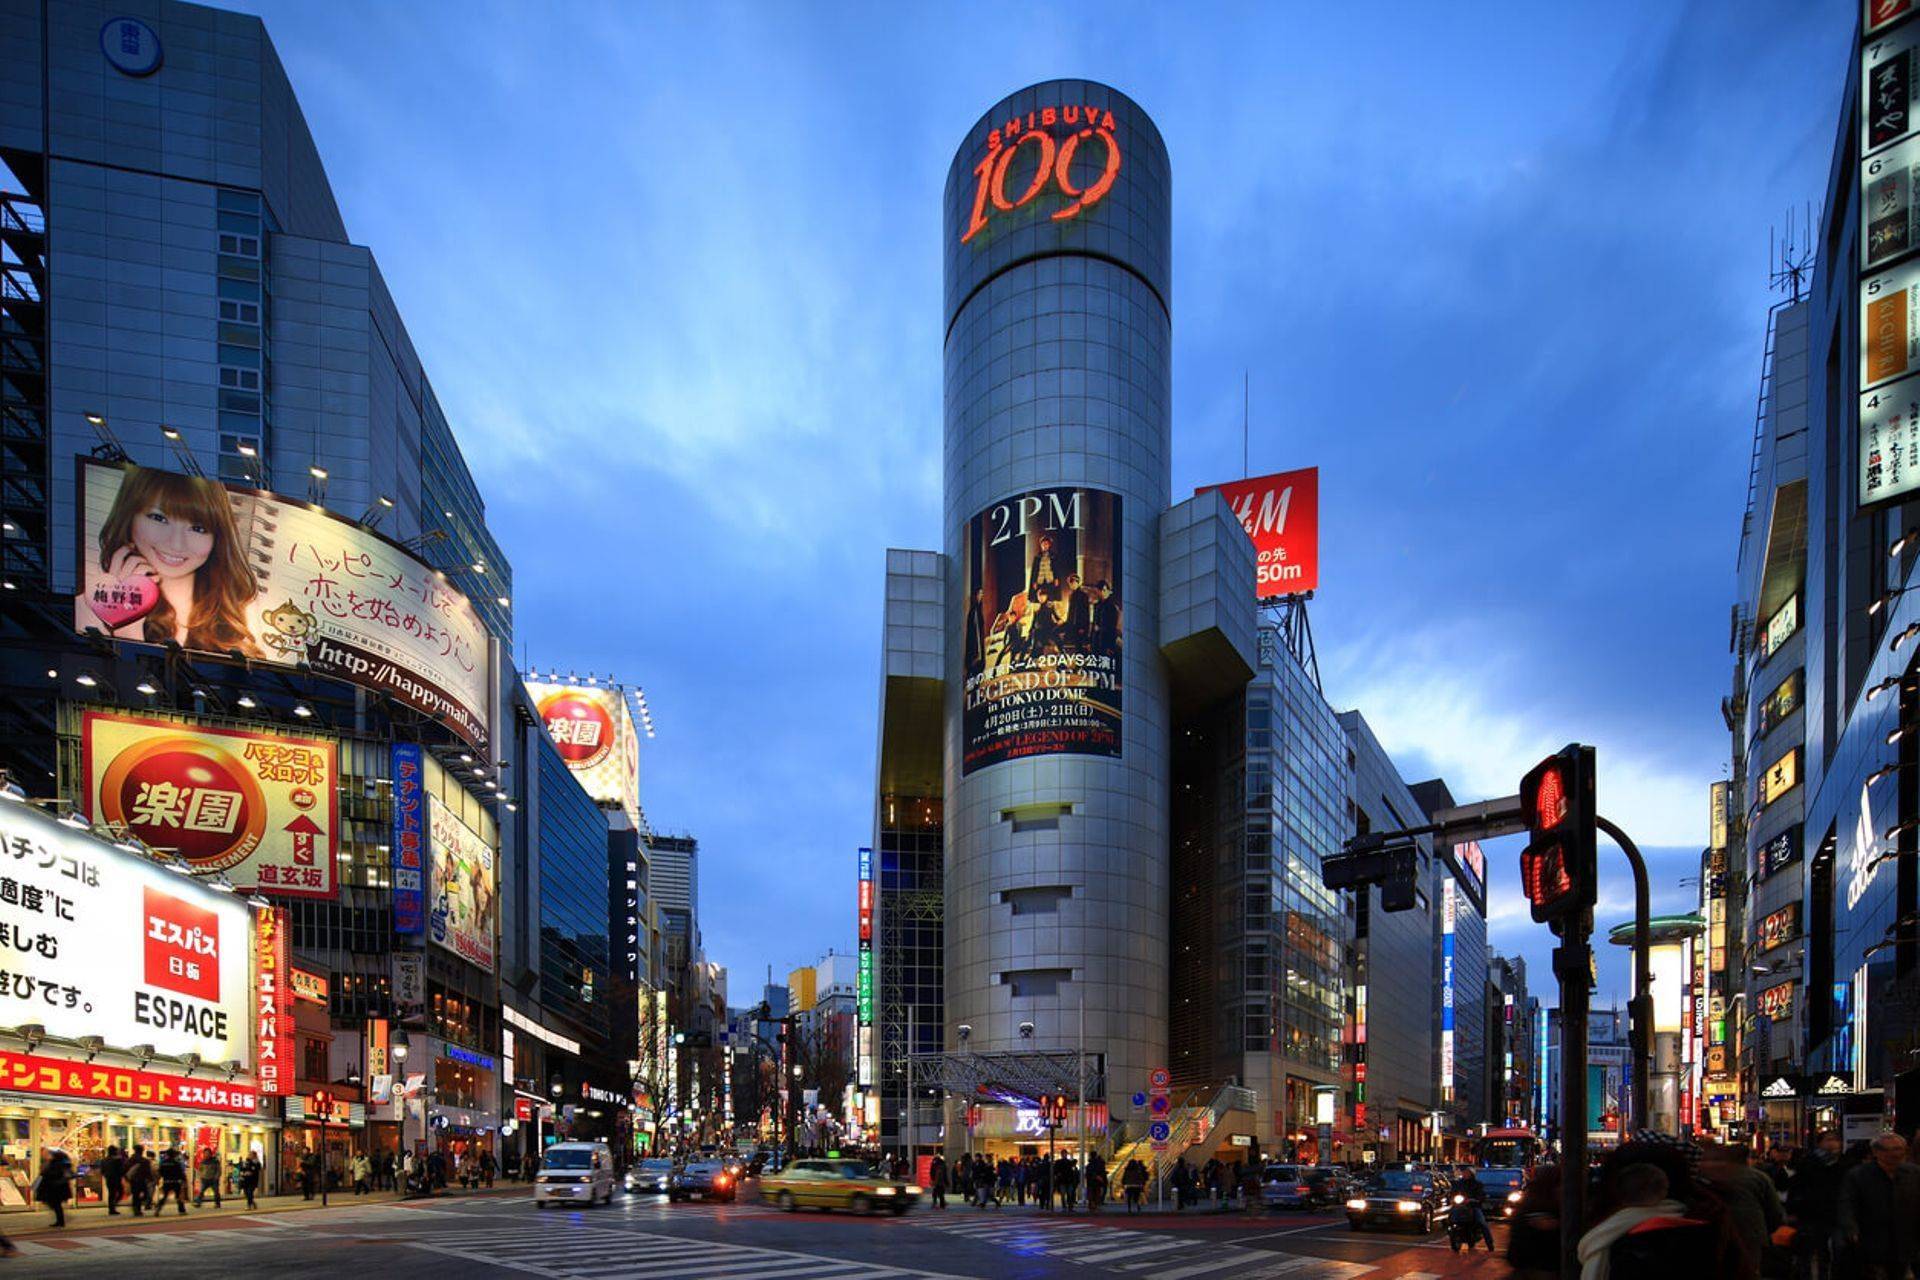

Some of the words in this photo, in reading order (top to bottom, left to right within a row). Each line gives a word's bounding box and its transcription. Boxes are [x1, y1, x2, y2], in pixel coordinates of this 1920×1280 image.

[988, 105, 1116, 149] SHIBUYA
[961, 128, 1122, 244] 109
[1868, 280, 1881, 295] 5
[990, 492, 1085, 547] 2PM
[966, 671, 1040, 711] LEGEND
[1044, 669, 1074, 688] OF
[1077, 667, 1116, 691] 2PM
[987, 702, 998, 714] in
[1000, 690, 1043, 709] TOKYO
[1046, 687, 1088, 701] DOME
[548, 717, 602, 746] 楽園
[258, 762, 323, 786] スロット
[130, 781, 243, 834] 楽園
[258, 863, 322, 887] 道玄坂
[148, 916, 218, 958] エスパス
[260, 907, 276, 970] パチンコ
[134, 991, 228, 1041] ESPACE
[260, 973, 276, 1060] エスパス
[68, 1072, 84, 1089] &
[91, 1071, 172, 1101] スロット
[178, 1085, 229, 1106] エスパス
